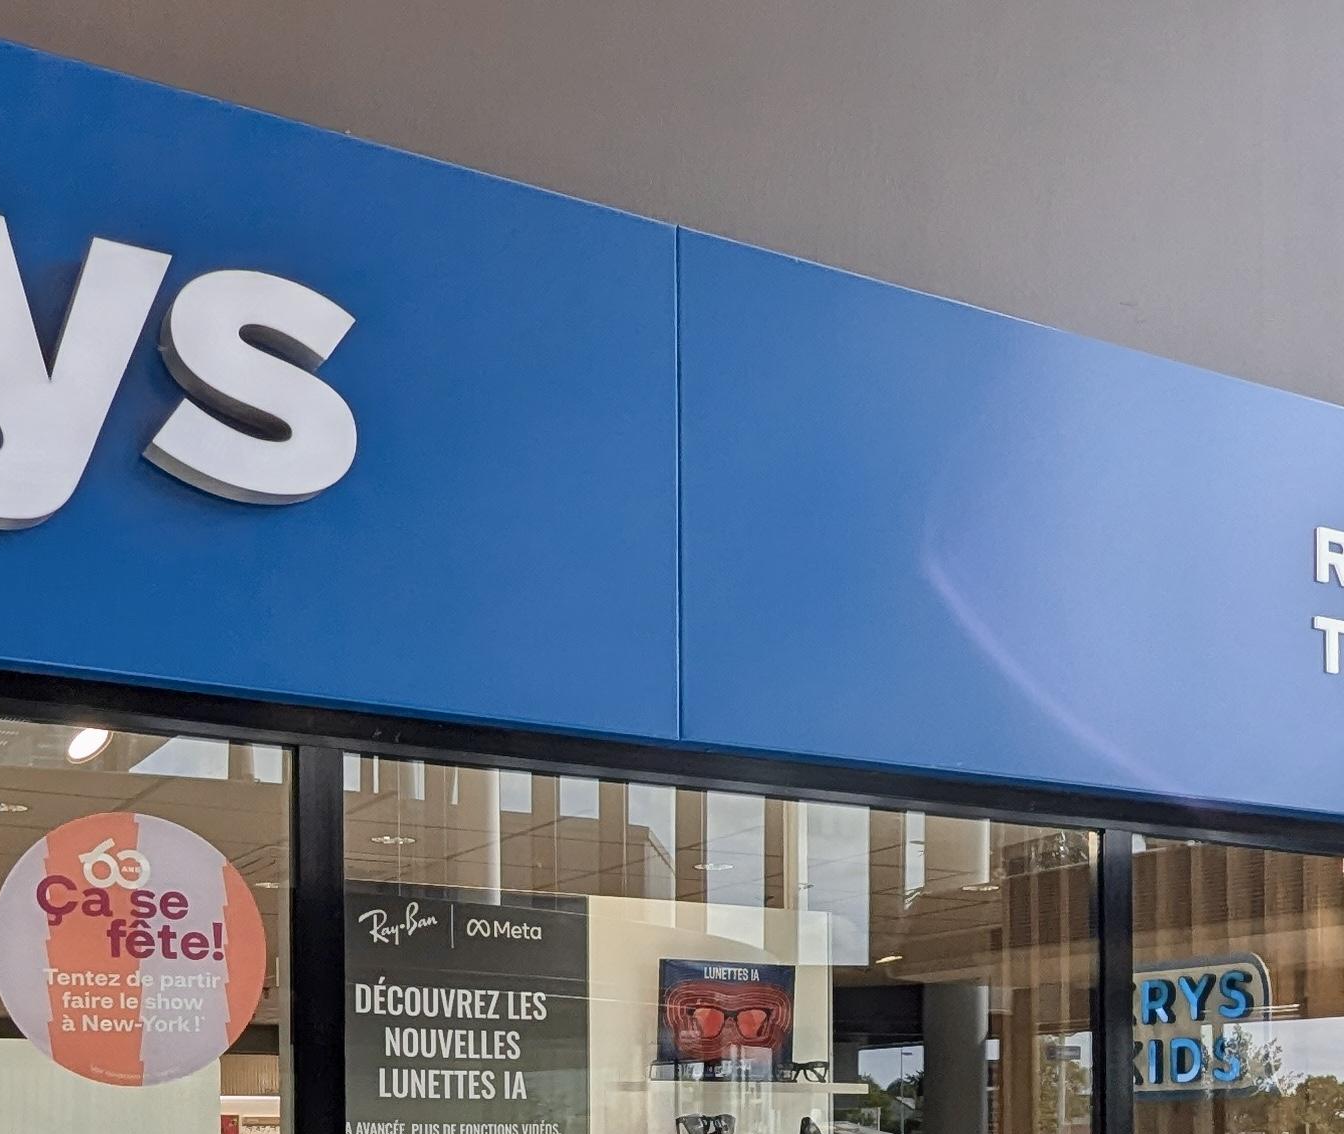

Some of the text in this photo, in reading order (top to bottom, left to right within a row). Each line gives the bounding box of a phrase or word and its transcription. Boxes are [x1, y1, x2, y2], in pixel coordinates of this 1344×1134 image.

[36, 875, 189, 926] Ça se
[106, 918, 225, 961] fête!
[493, 919, 543, 941] Meta
[43, 968, 221, 991] Tentez de partir
[704, 966, 760, 981] LUNETTES IA
[62, 992, 203, 1010] faire le show
[355, 976, 548, 1021] DÉCOUVREZ LES
[62, 1014, 75, 1031] à
[82, 1014, 190, 1032] New-York
[384, 1027, 521, 1060] NOUVELLES
[378, 1067, 528, 1100] LUNETTES IA
